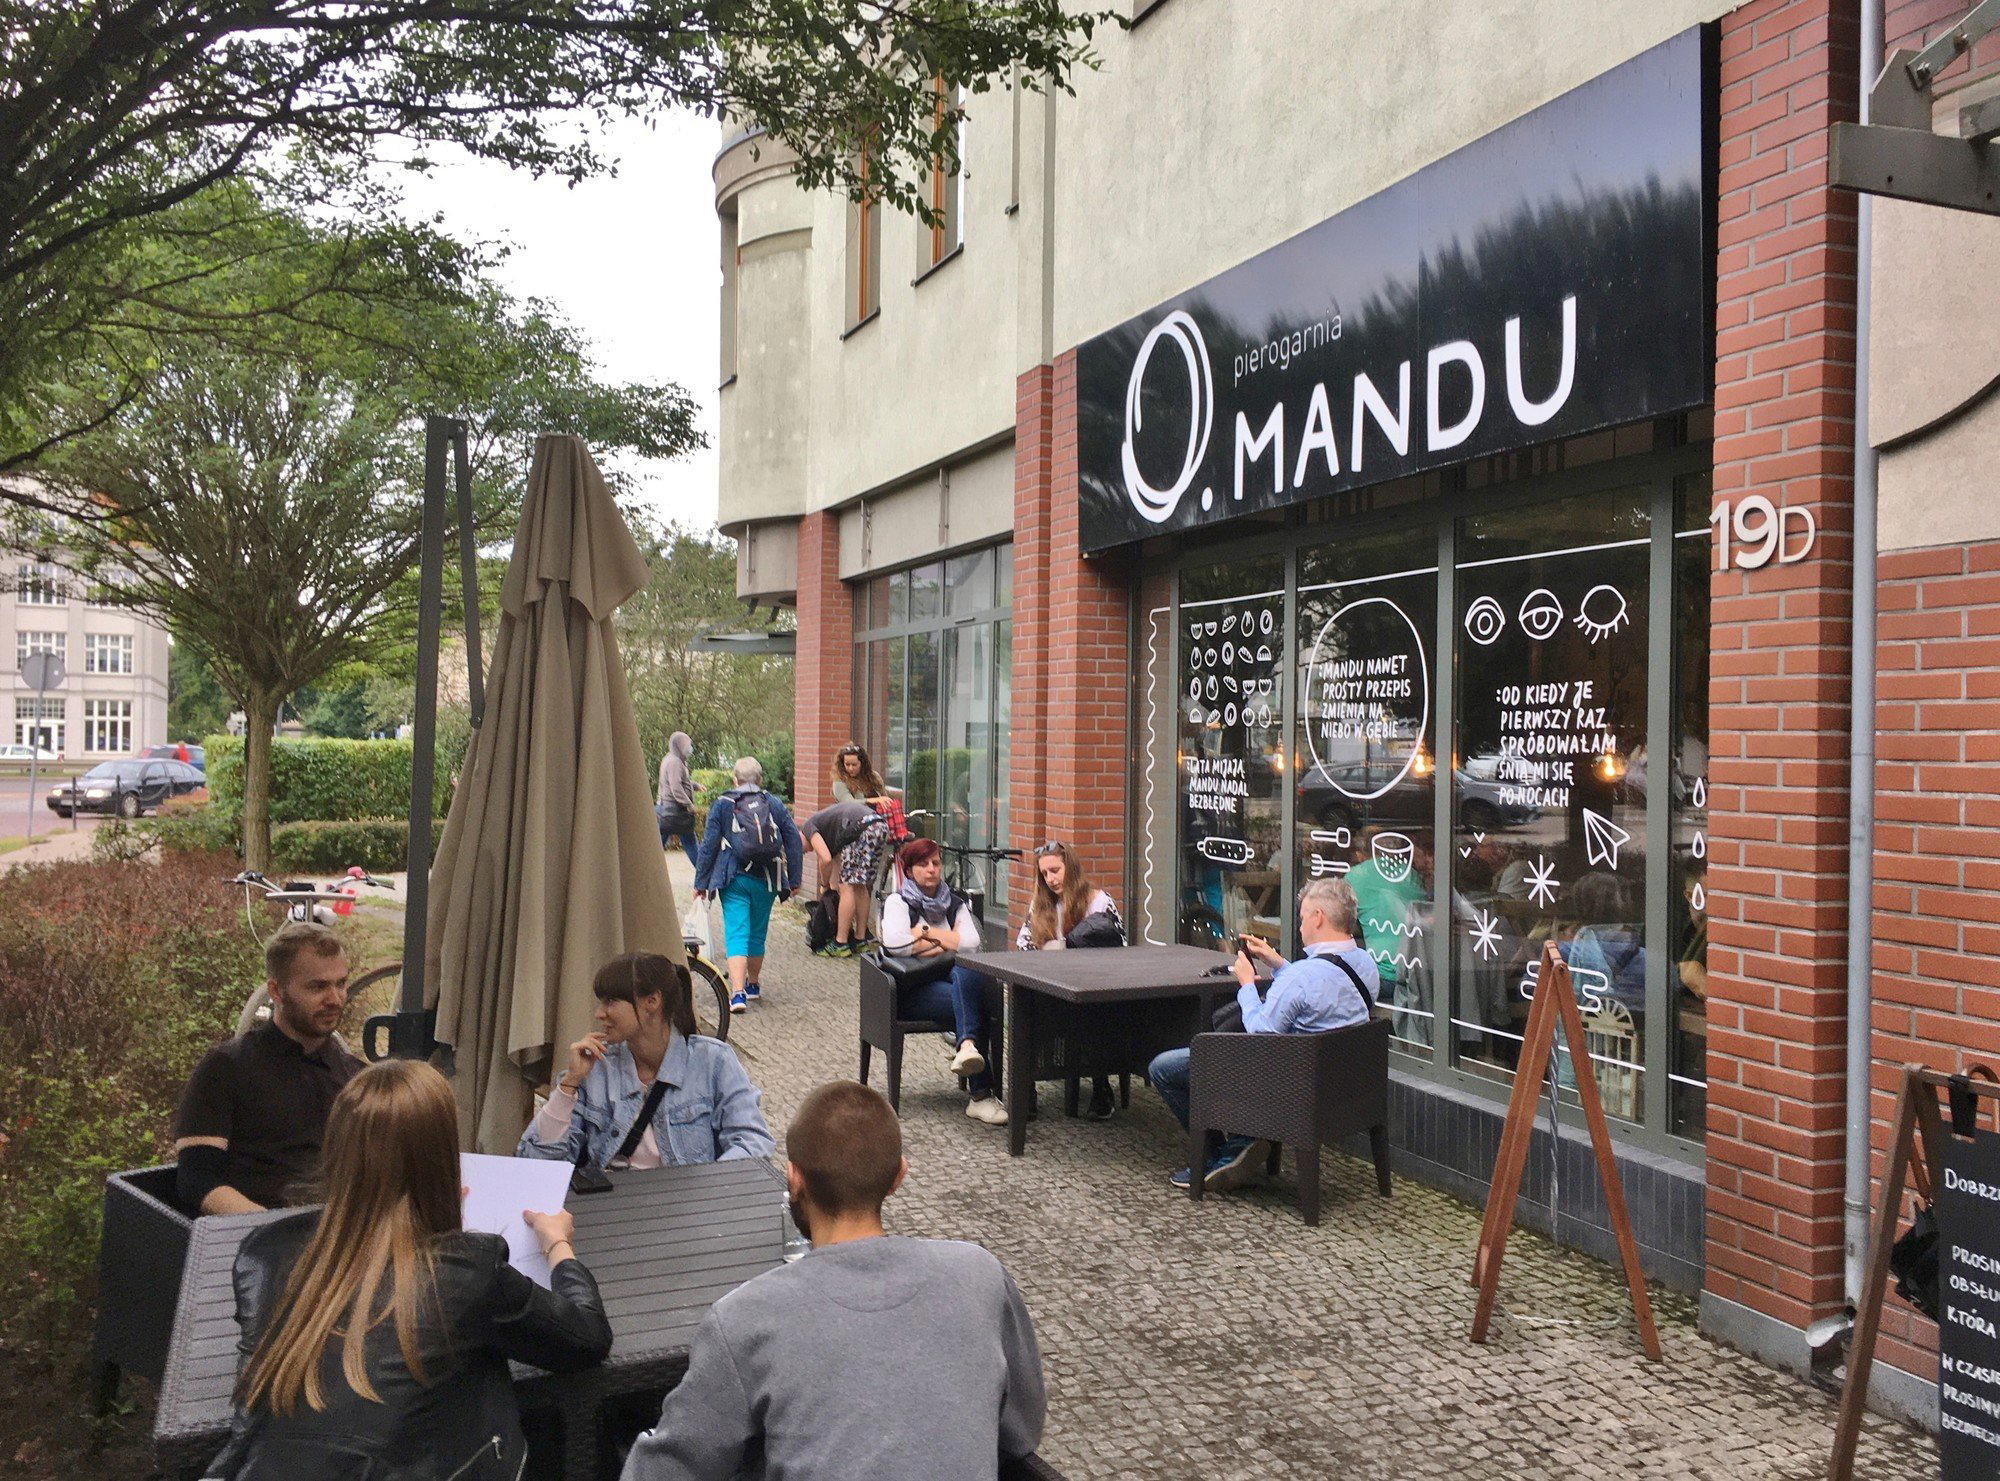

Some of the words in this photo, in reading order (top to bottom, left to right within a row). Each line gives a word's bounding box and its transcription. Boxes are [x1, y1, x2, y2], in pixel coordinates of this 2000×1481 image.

[1233, 309, 1344, 388] pierogarnia
[1709, 495, 1816, 570] 19D
[1367, 654, 1408, 676] NAWET
[1322, 680, 1363, 700] PROSTY
[1365, 679, 1411, 699] PRZEPIS
[1525, 681, 1569, 705] KIEDY
[1573, 680, 1594, 709] JE
[1321, 702, 1365, 720] ZMIENIA
[1368, 702, 1383, 719] NA
[1500, 708, 1572, 731] PIERWSZY
[1576, 707, 1607, 730] RAZ
[1321, 721, 1351, 739] NIEBO
[1353, 722, 1363, 739] W
[1499, 731, 1617, 756] SPRÓBOWAŁAM
[1533, 761, 1549, 781] MI
[1552, 761, 1575, 785] SIĘ
[1189, 776, 1218, 793] MANDU
[1220, 779, 1250, 797] NADAL
[1498, 787, 1514, 806] PO
[1517, 787, 1569, 807] NOCACH
[1941, 1352, 1954, 1373] W
